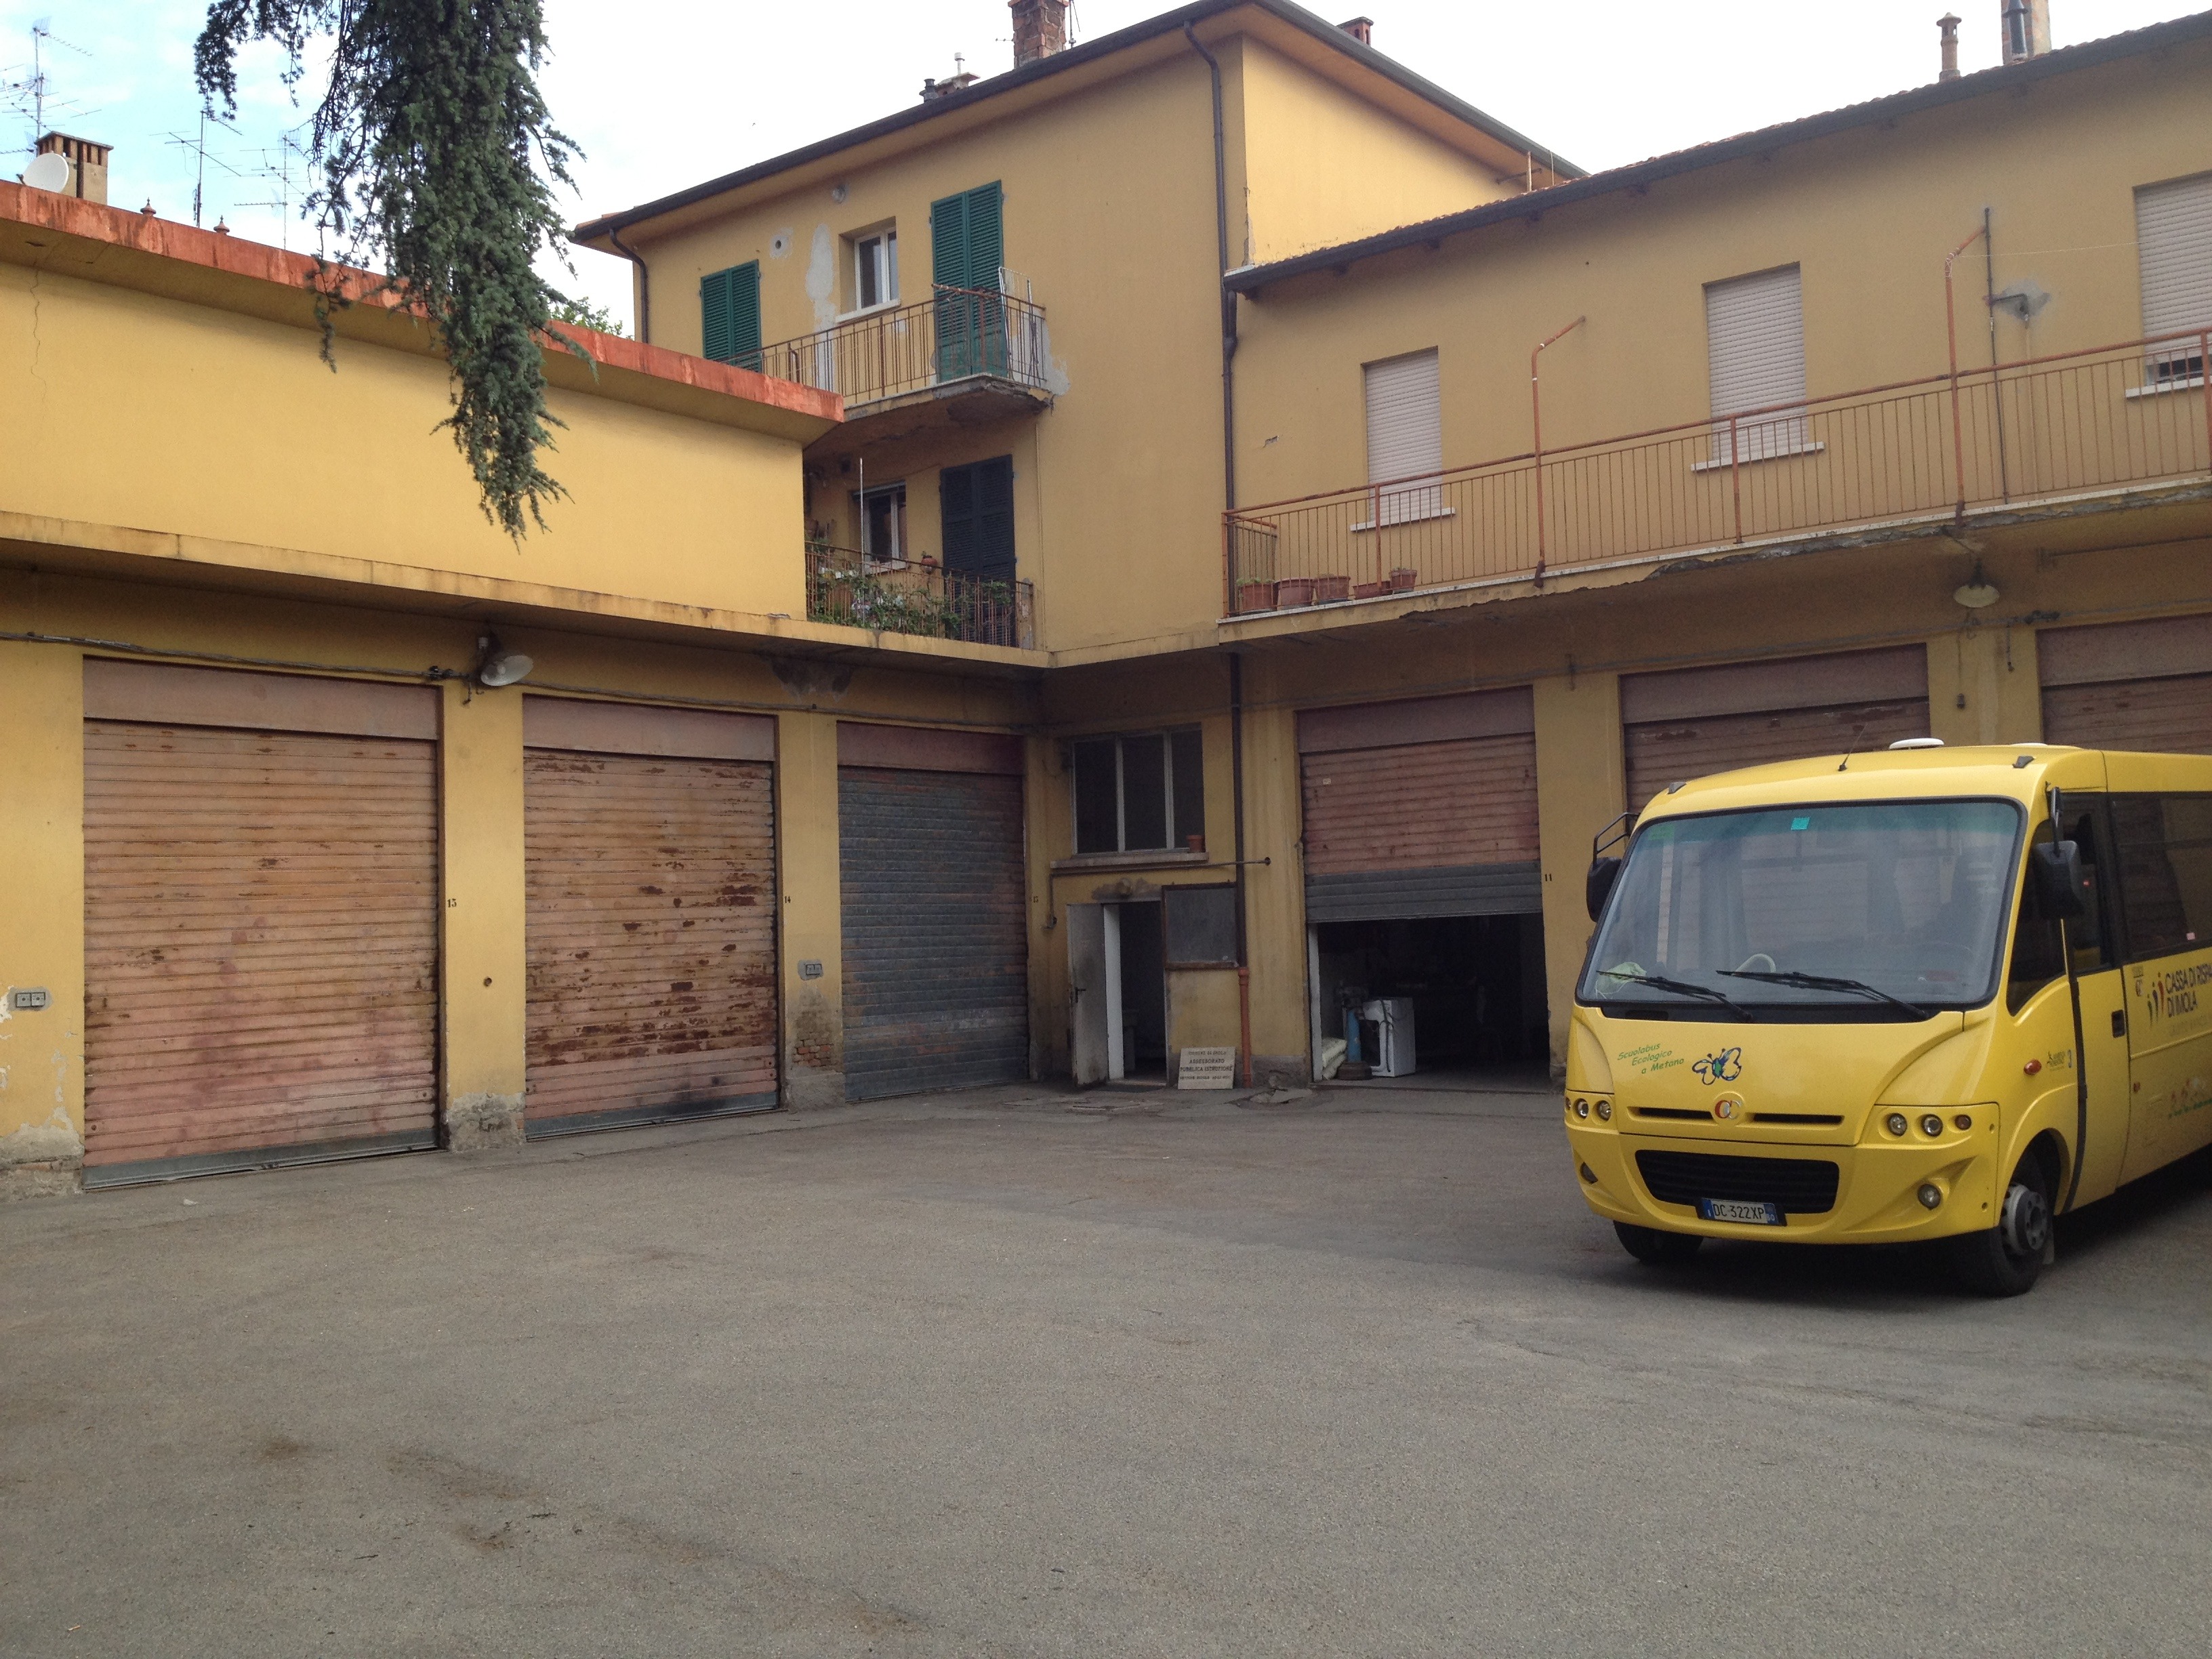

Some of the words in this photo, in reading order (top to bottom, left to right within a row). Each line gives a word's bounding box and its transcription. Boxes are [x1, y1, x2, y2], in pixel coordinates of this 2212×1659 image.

[447, 898, 457, 907] 15
[2165, 969, 2188, 994] CASSA
[2189, 967, 2196, 987] DI
[2167, 997, 2174, 1017] DI
[2175, 990, 2198, 1015] IMOLA
[1617, 1044, 1660, 1060] Scuolabus
[1632, 1050, 1672, 1065] Ecologico
[1651, 1059, 1684, 1071] Metano
